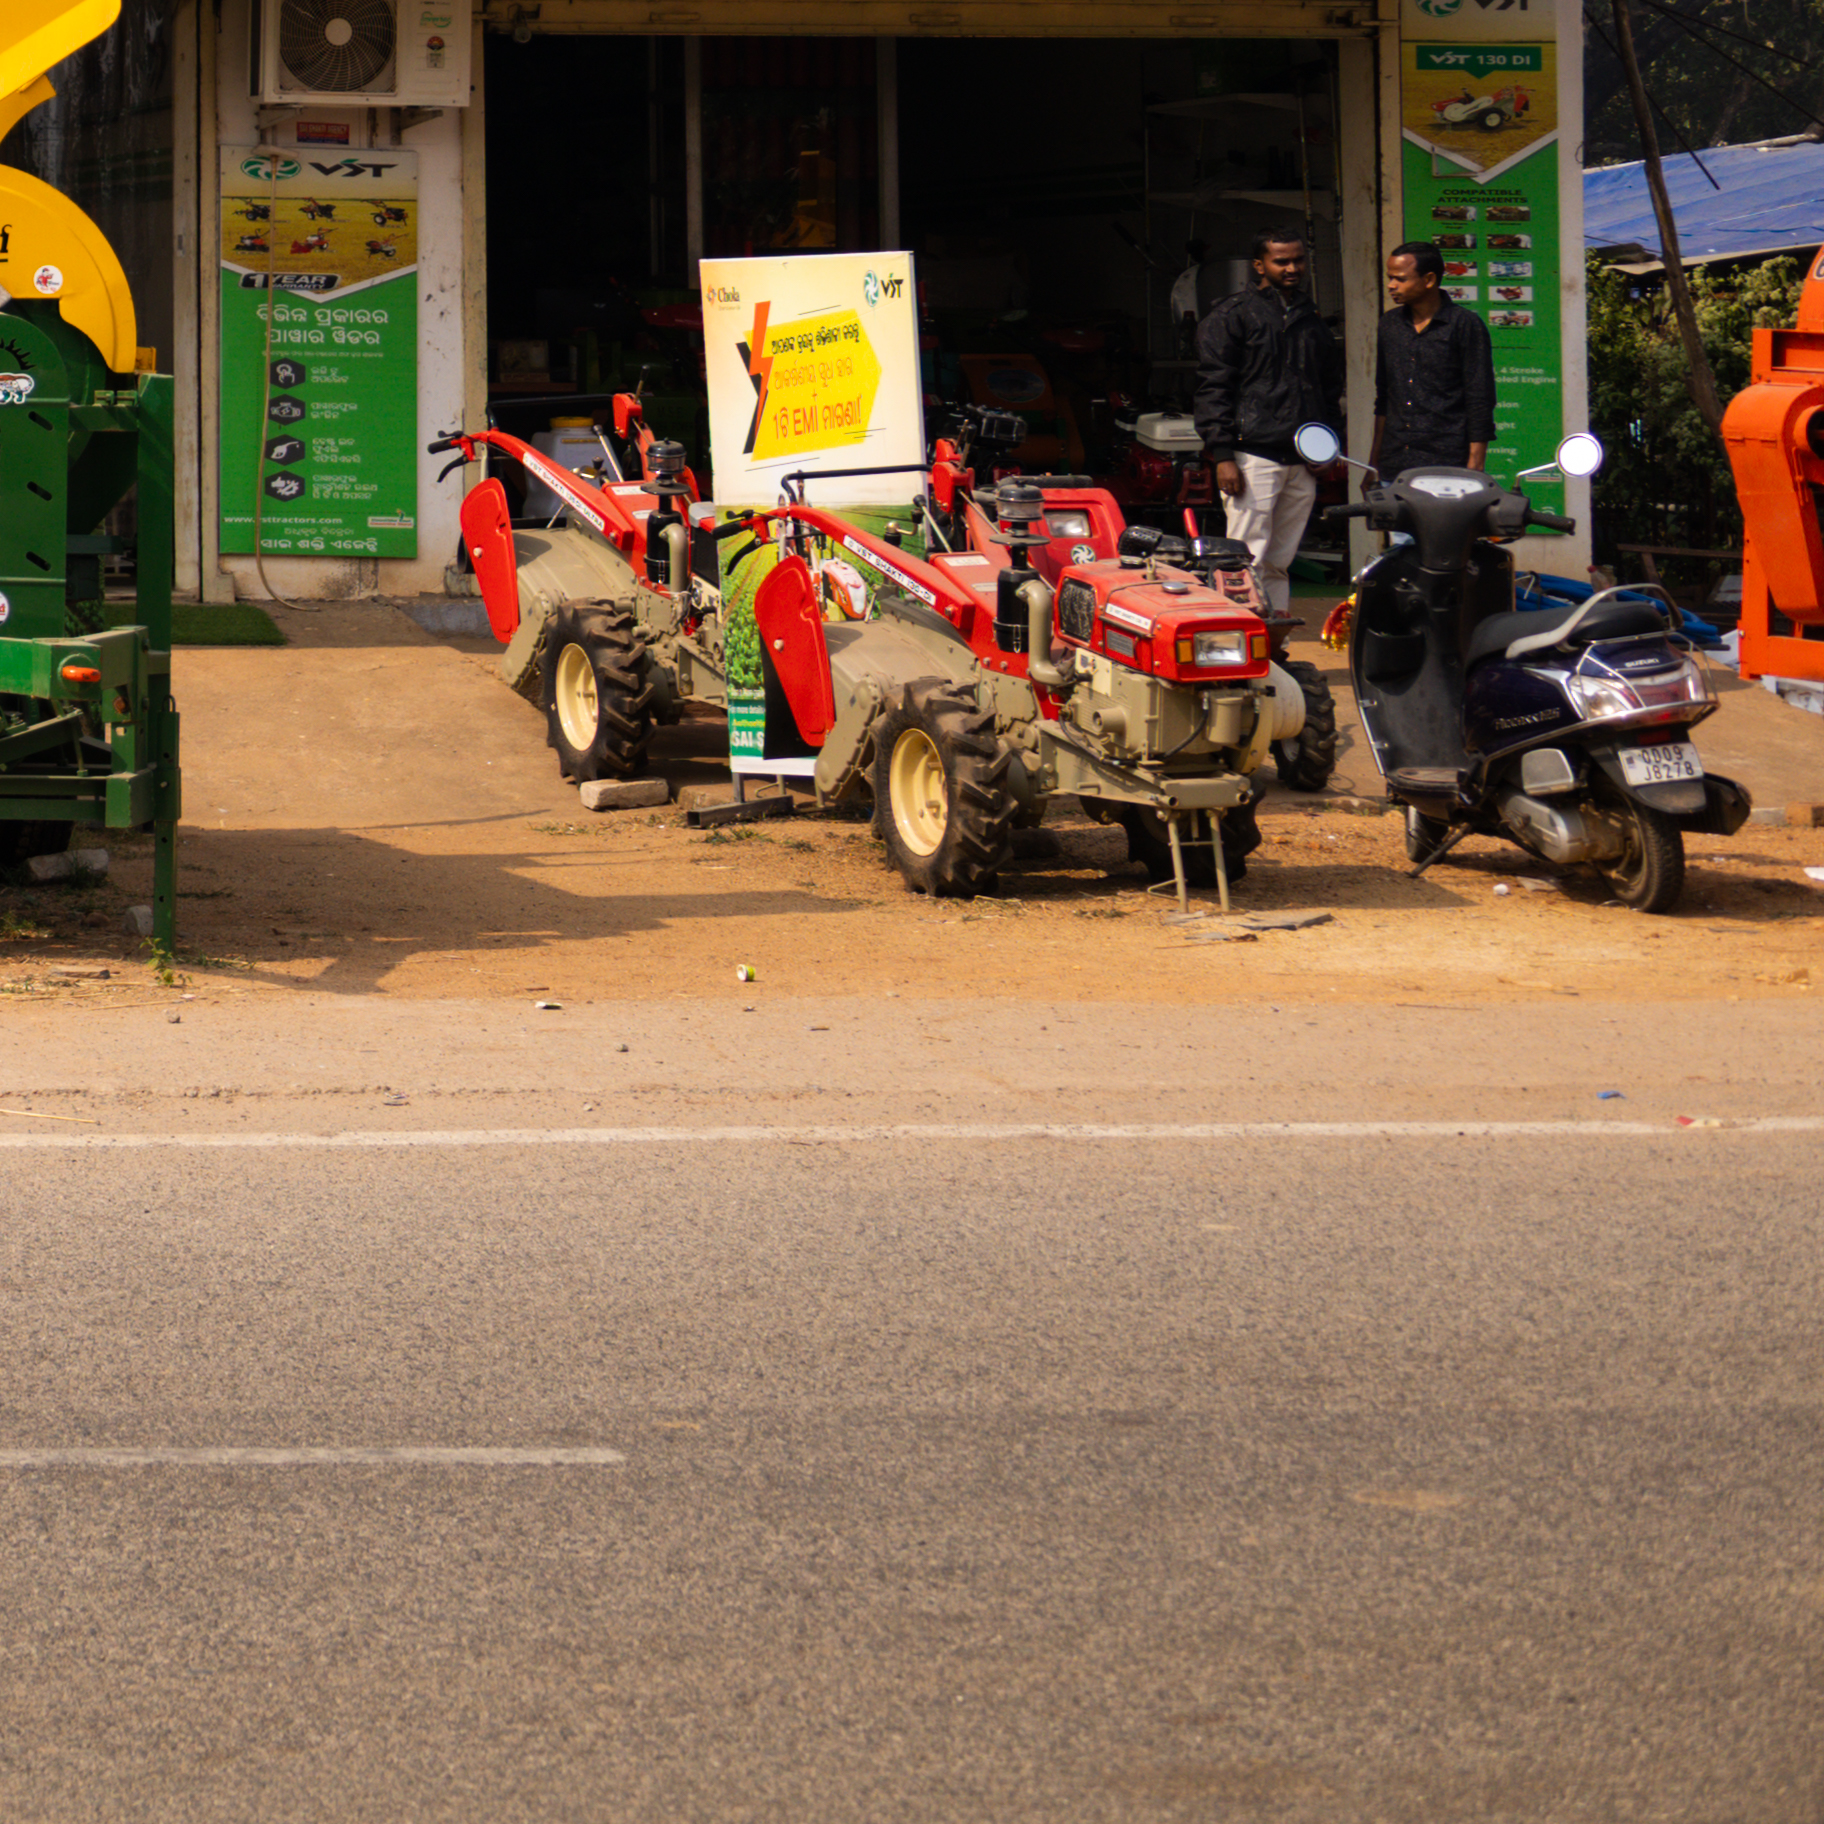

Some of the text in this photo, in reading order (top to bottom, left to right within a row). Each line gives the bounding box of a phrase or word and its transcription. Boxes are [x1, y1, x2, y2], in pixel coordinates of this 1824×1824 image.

[1429, 51, 1530, 65] VST 130 DI
[308, 158, 399, 178] VST
[718, 287, 740, 303] Chola
[881, 273, 904, 298] VST
[1521, 376, 1557, 384] Engine
[793, 405, 819, 436] EMI
[1643, 761, 1695, 782] J8278
